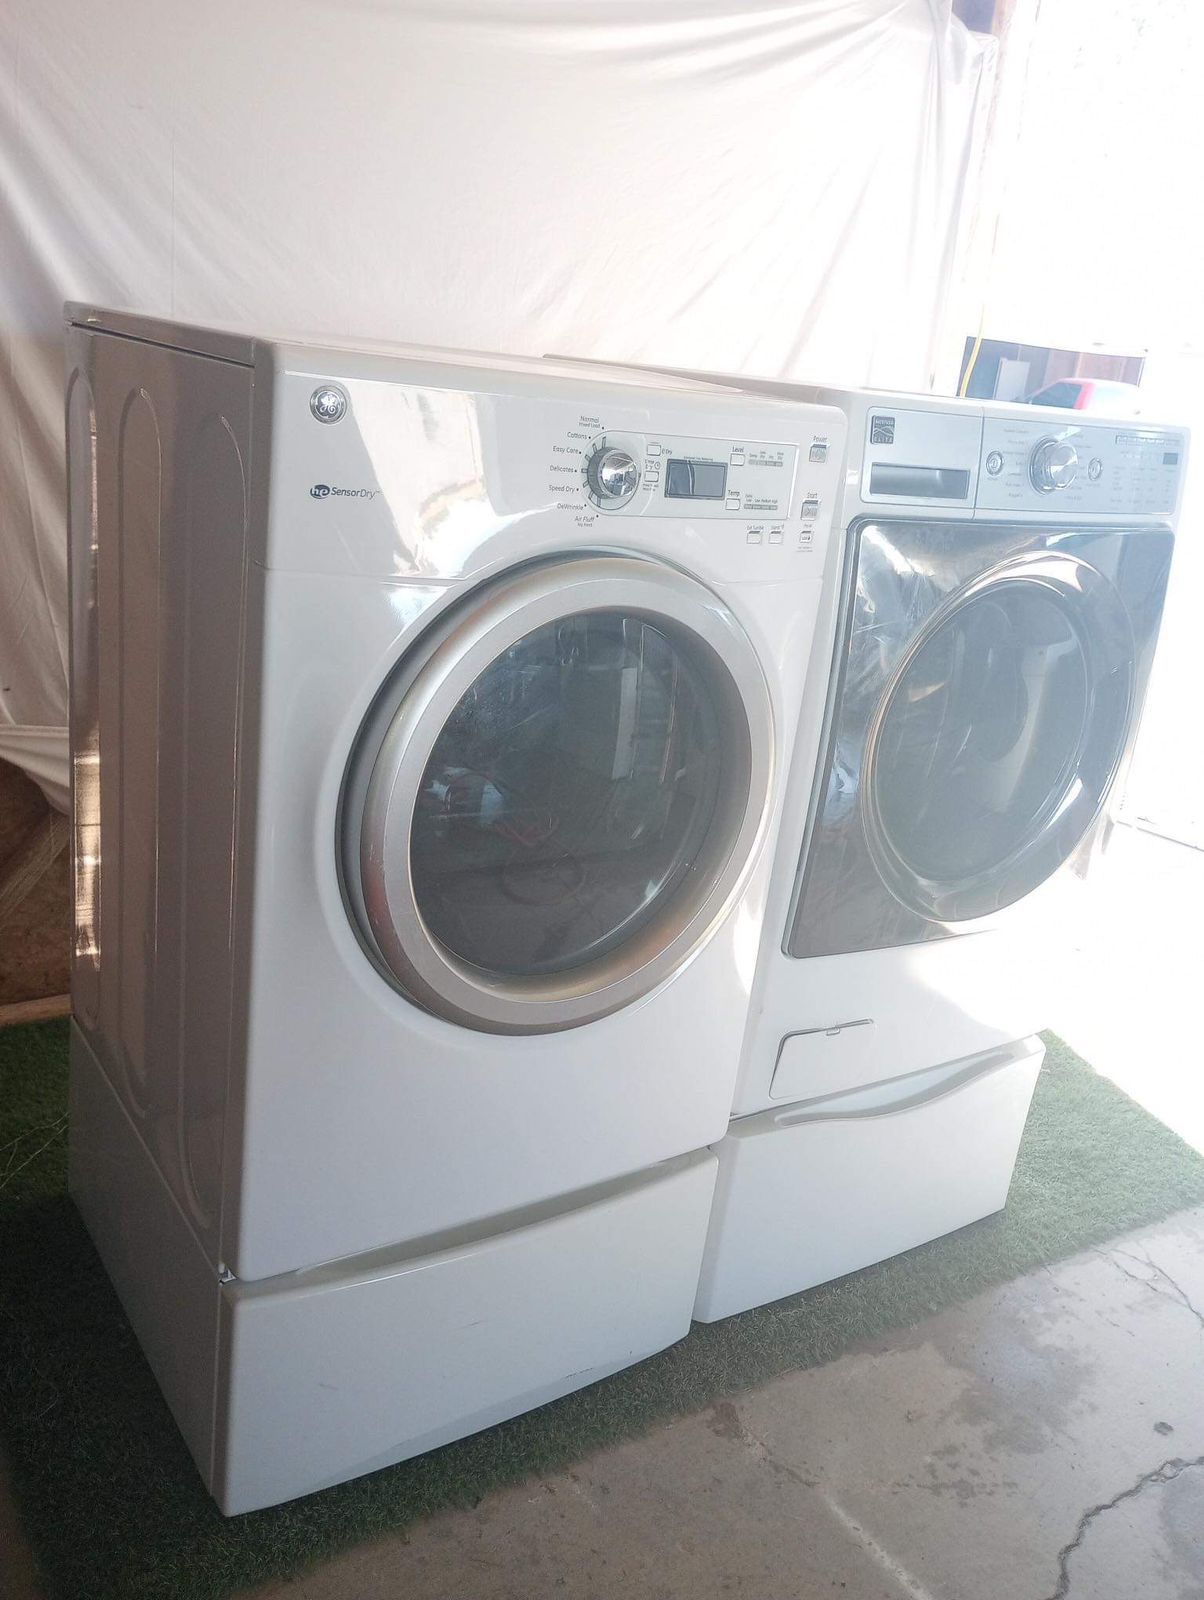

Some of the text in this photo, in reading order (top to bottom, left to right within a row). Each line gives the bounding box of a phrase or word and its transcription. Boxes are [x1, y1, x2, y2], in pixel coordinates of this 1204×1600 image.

[580, 415, 600, 423] Normal
[567, 431, 587, 439] Cottons
[553, 445, 565, 453] Easy
[550, 464, 574, 472] Delicates
[549, 484, 575, 493] Speed Dry
[728, 489, 740, 497] Temp
[556, 502, 584, 510] DeWrinkle
